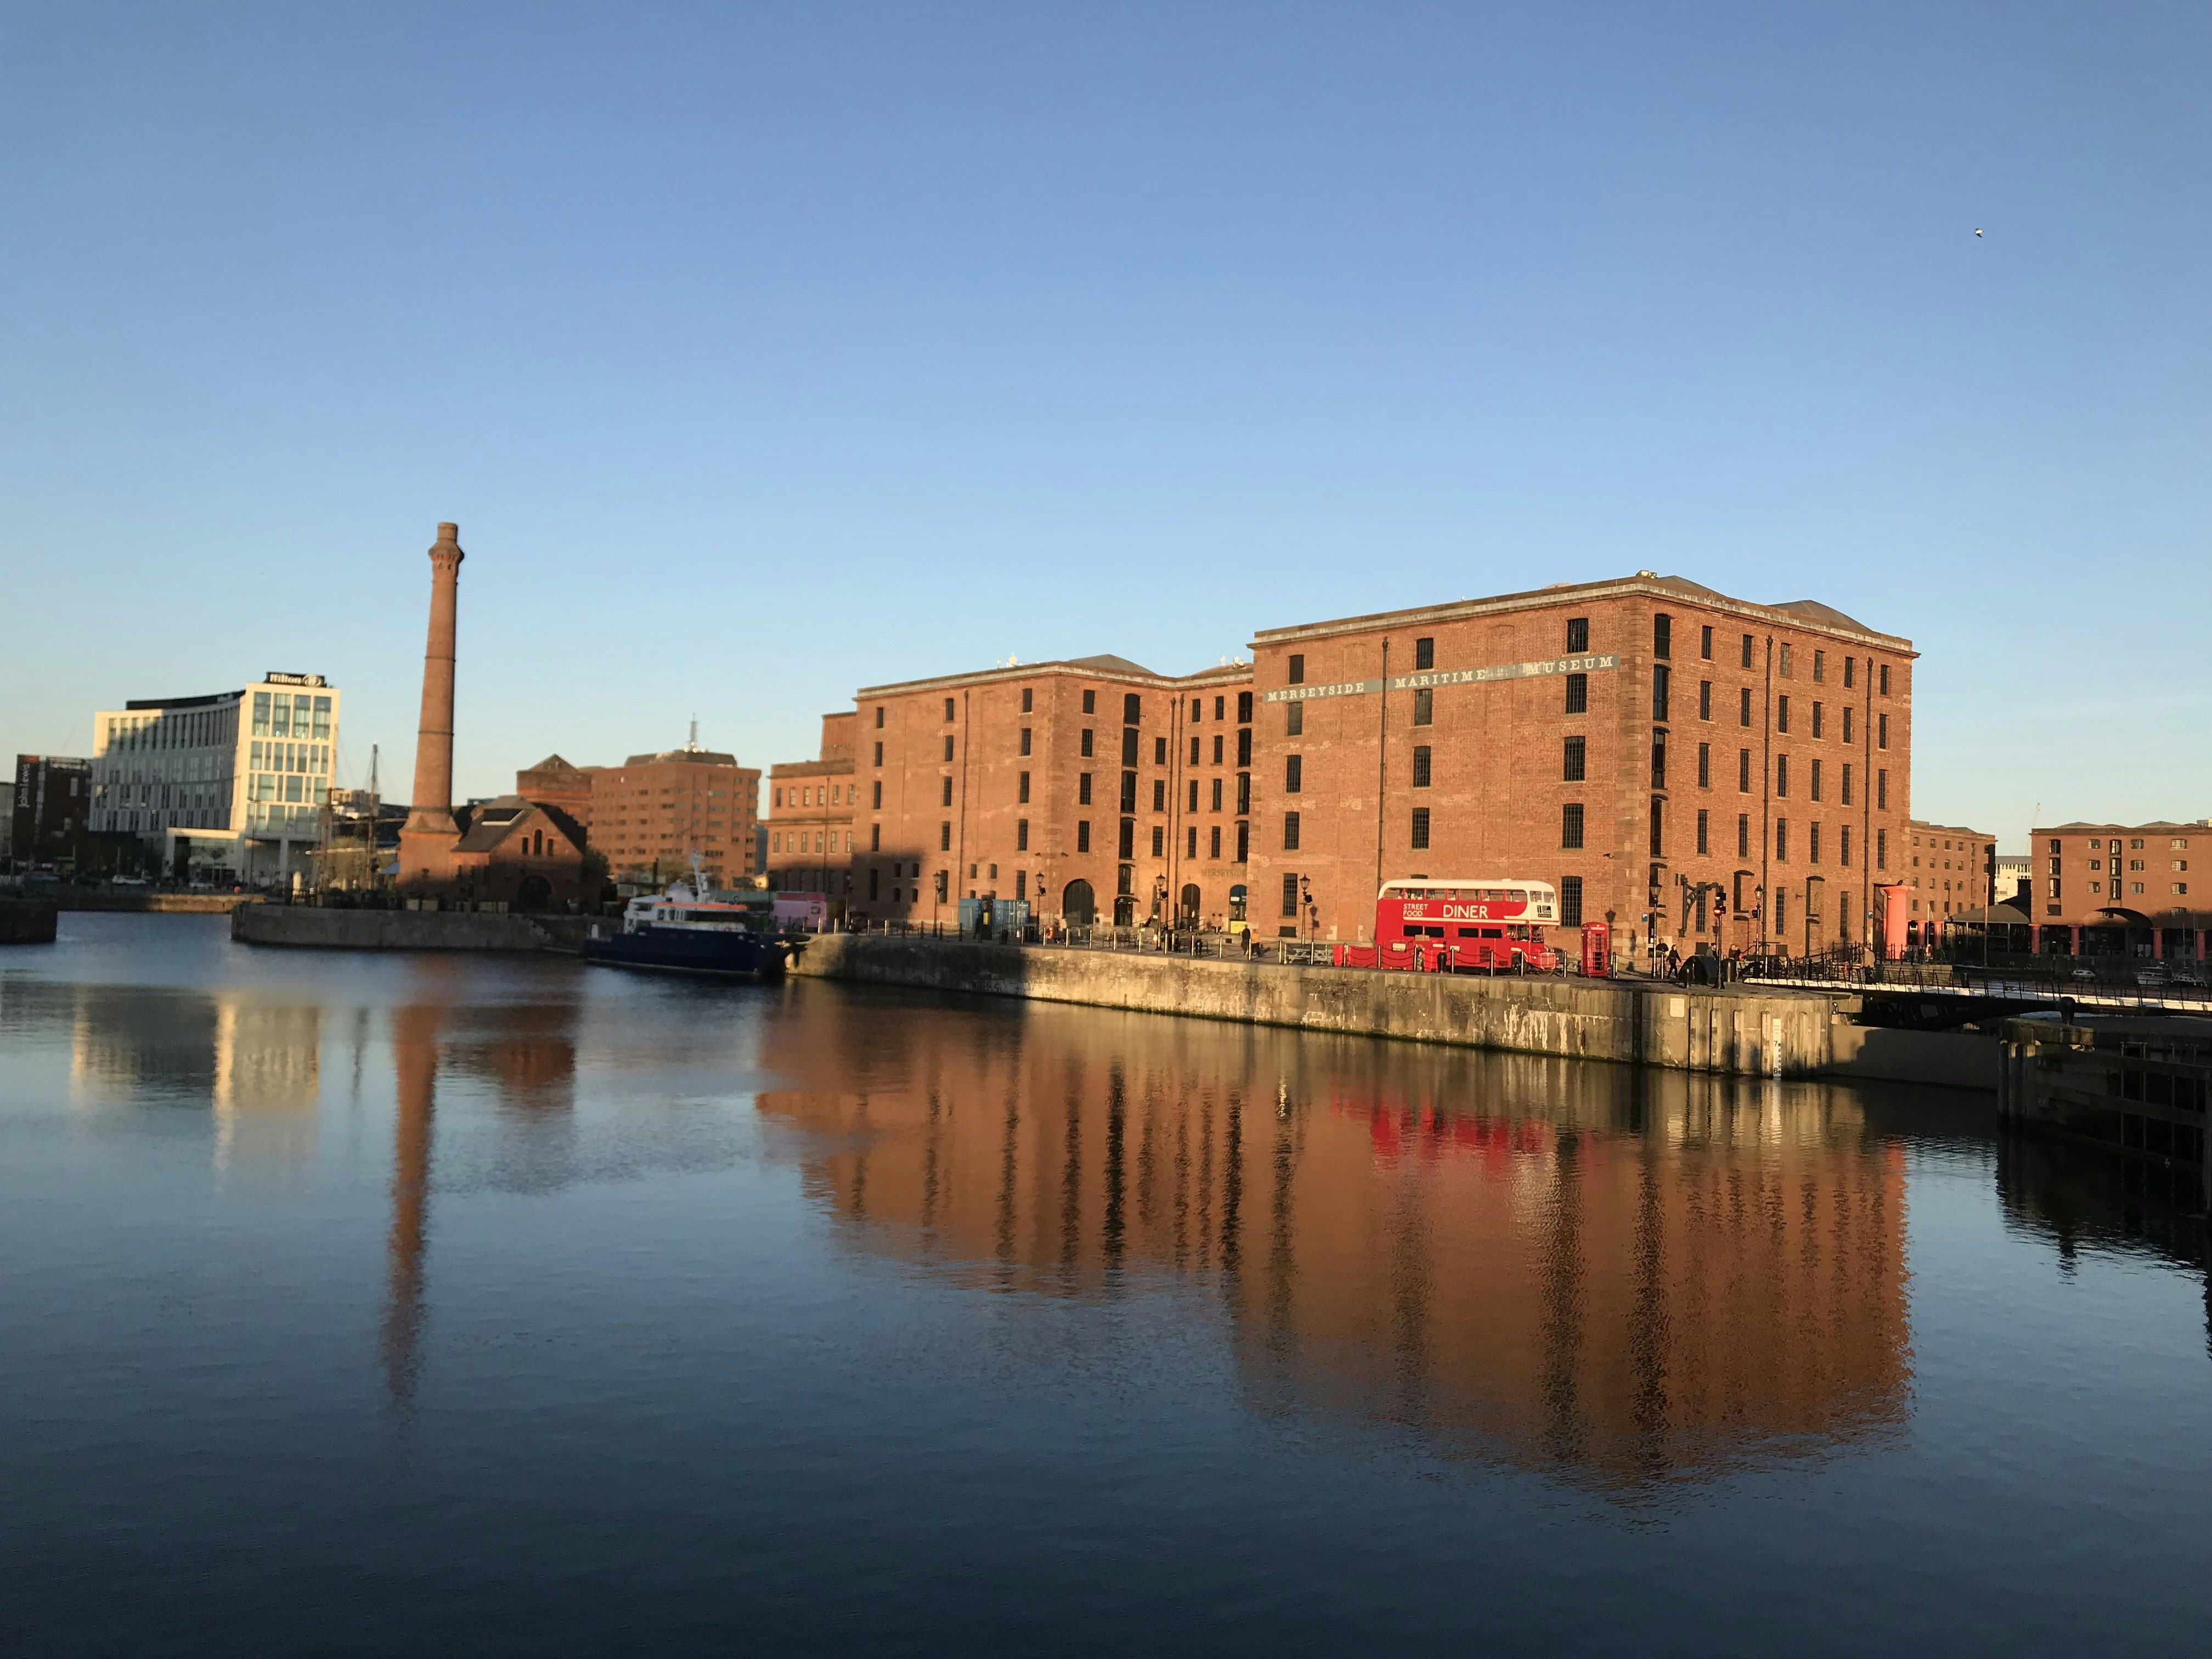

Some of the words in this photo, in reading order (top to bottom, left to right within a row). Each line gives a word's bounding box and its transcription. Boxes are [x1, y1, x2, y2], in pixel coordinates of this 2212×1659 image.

[270, 674, 301, 684] Hilton
[1267, 682, 1364, 701] MERSEYSIDE
[1395, 669, 1486, 688] MARITIME
[1526, 656, 1613, 675] MUSEUM
[1443, 904, 1488, 919] DINER
